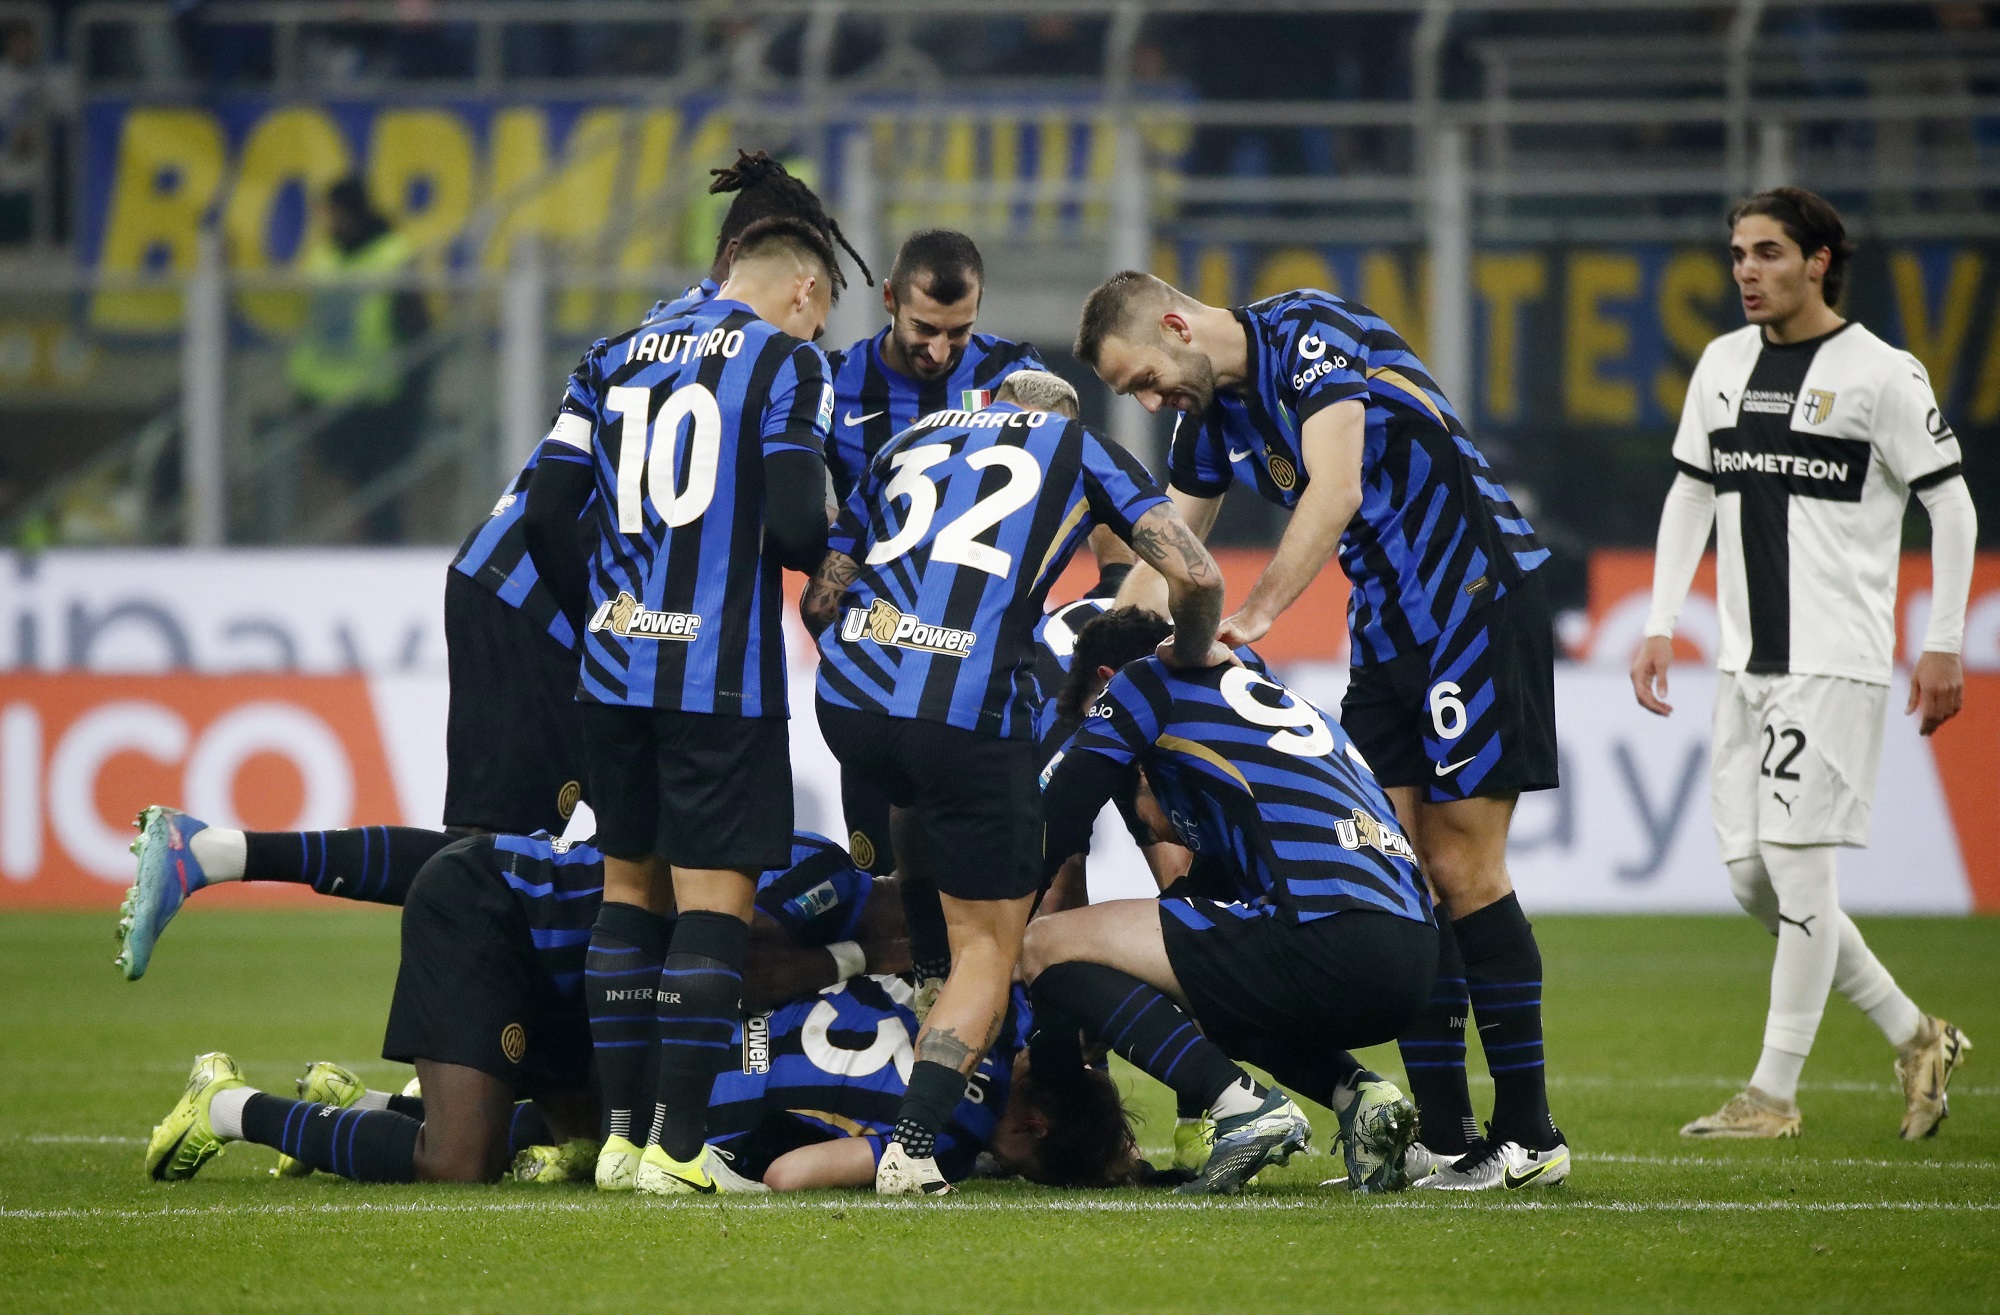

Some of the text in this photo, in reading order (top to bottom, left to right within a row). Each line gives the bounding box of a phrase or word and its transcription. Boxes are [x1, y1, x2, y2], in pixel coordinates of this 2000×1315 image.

[625, 327, 746, 366] LAUTARO
[1292, 355, 1348, 391] Gate.io
[914, 409, 1049, 432] DIMARCO
[606, 381, 722, 535] 10
[1712, 447, 1849, 482] PROMETEON
[864, 443, 1042, 580] 32
[1429, 680, 1468, 740] 6
[1760, 723, 1807, 783] 22
[606, 988, 653, 1002] INTER
